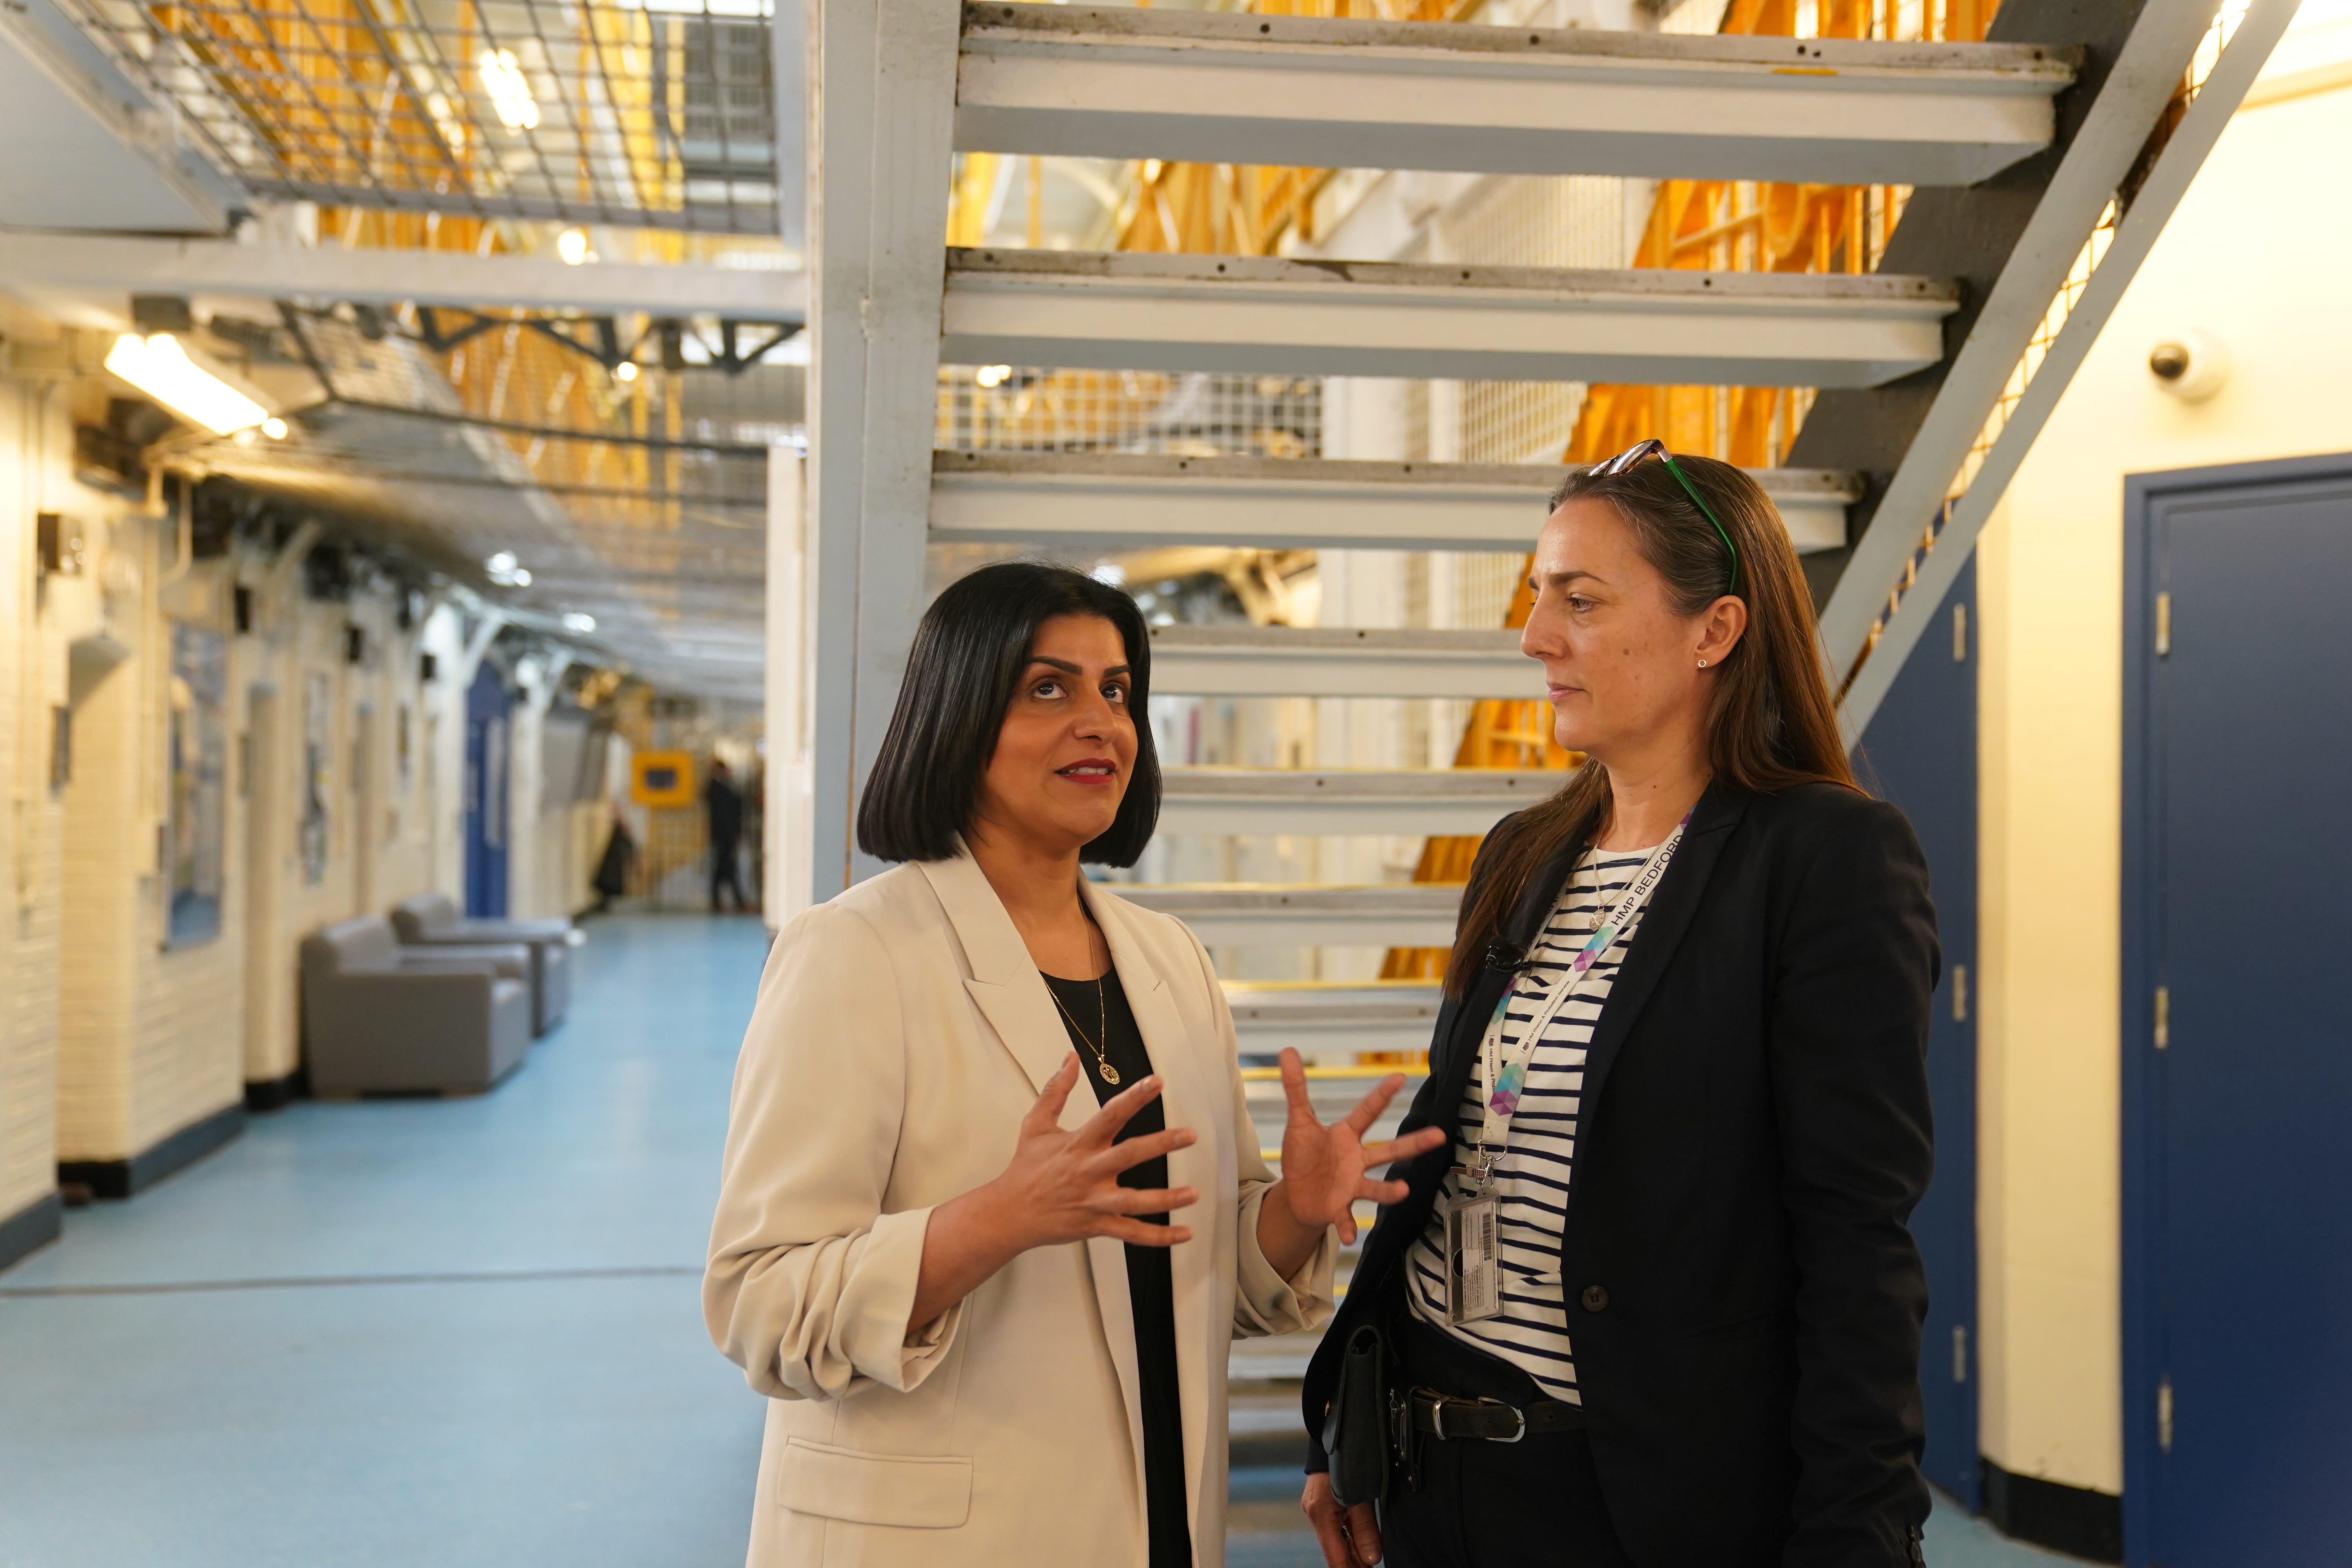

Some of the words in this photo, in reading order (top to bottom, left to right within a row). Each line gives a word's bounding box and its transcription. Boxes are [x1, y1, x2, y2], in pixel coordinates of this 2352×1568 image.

[1611, 897, 1634, 926] HMP
[1634, 835, 1682, 895] BEDFORD
[1528, 1033, 1534, 1041] HM
[1533, 1019, 1543, 1033] Prison
[1544, 996, 1559, 1015] Probation
[1558, 981, 1570, 995] Service
[1489, 1048, 1493, 1057] HM
